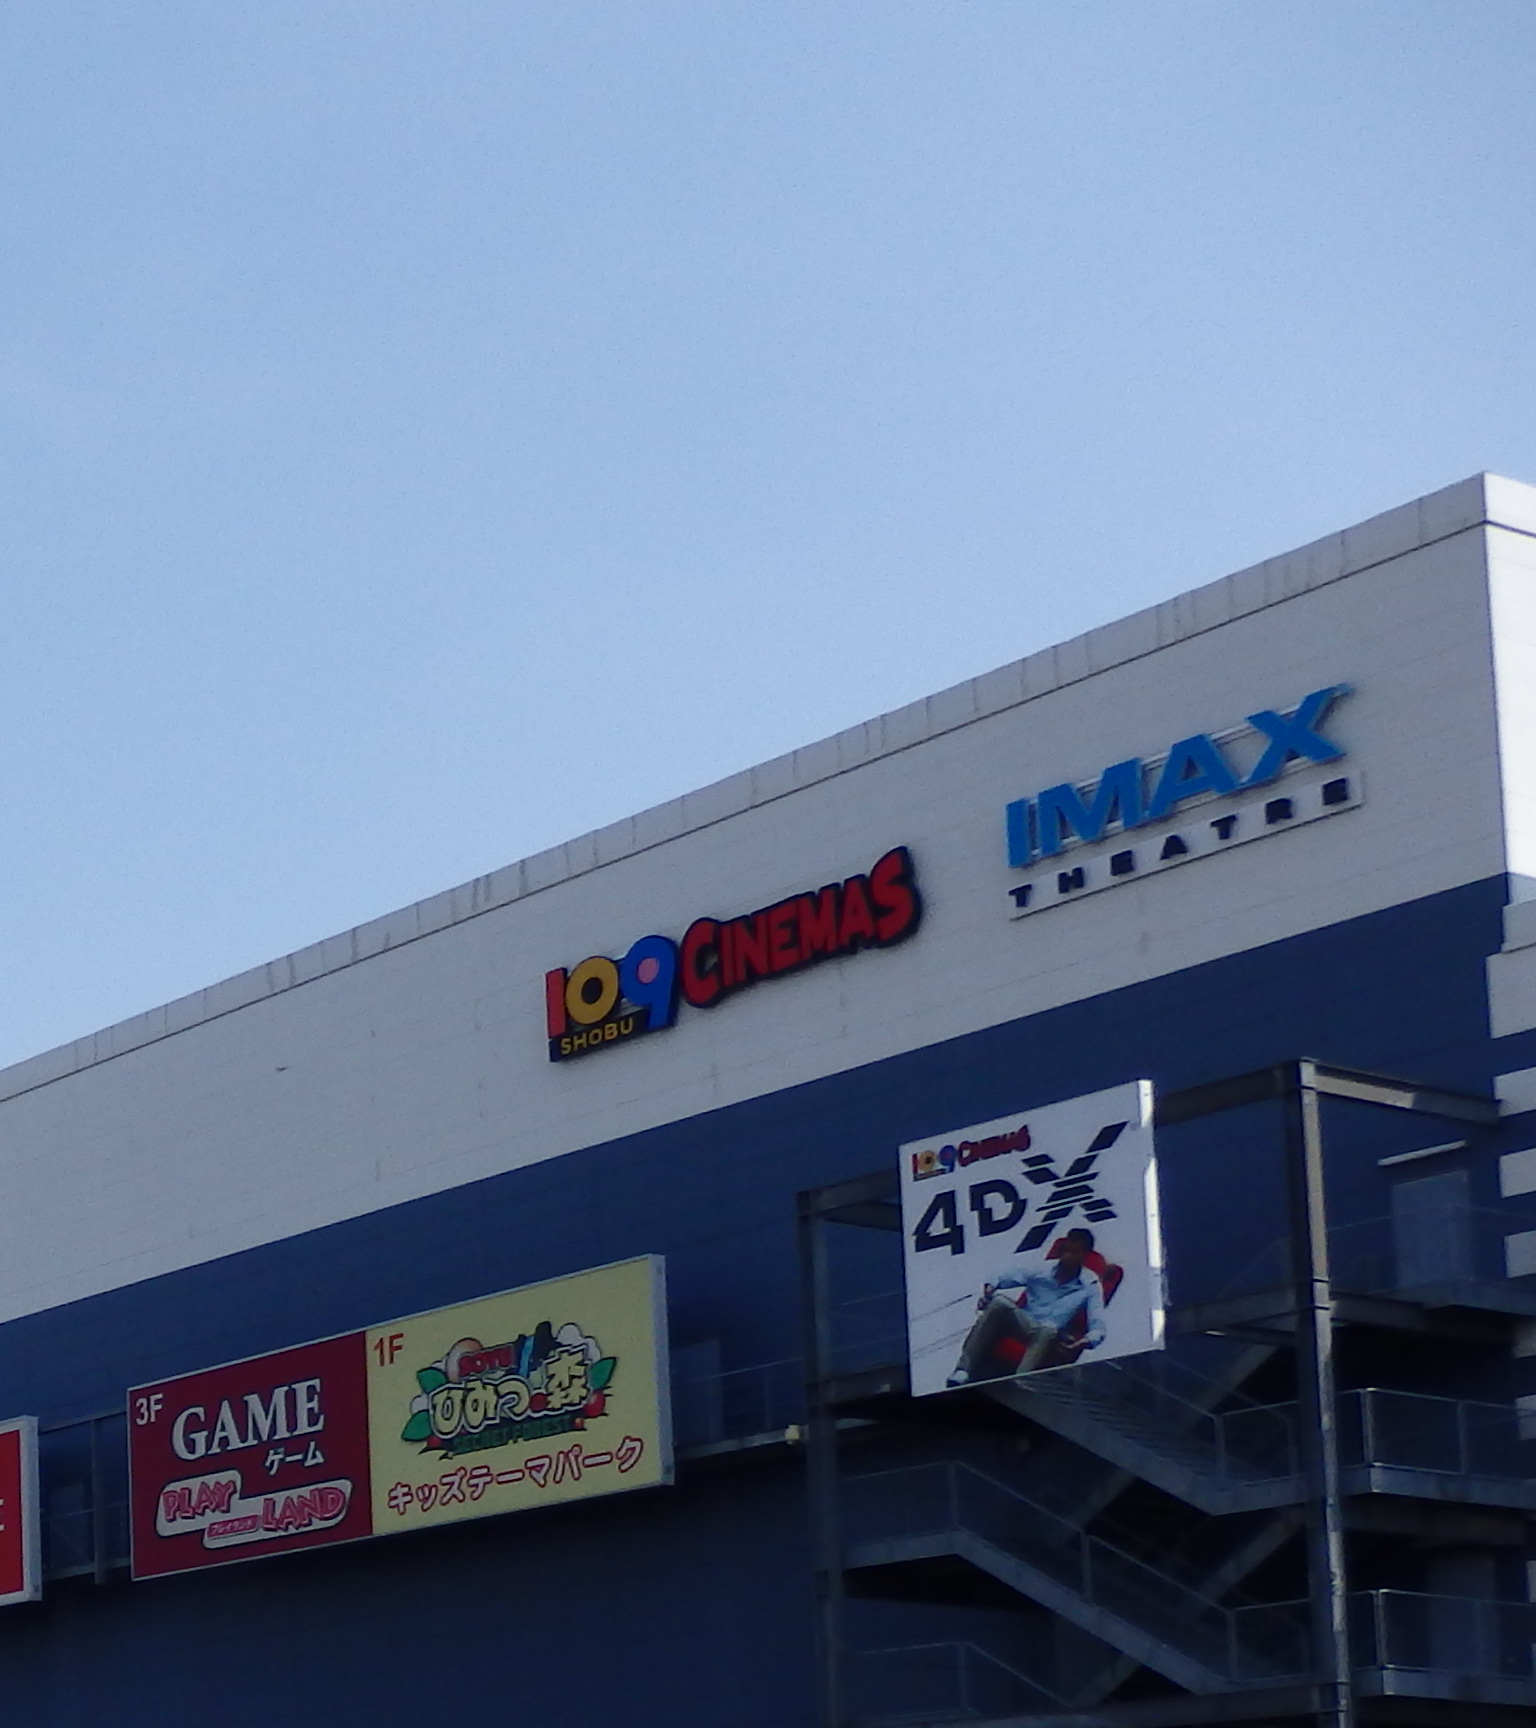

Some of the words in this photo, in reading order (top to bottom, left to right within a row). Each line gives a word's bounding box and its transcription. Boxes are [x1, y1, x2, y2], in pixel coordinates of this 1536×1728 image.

[1006, 682, 1356, 868] IMAX
[1008, 777, 1349, 908] THEATRE
[545, 934, 680, 1038] 109
[679, 846, 921, 1008] CINEMAS
[561, 1017, 634, 1055] SHOBU
[912, 1144, 958, 1181] 109
[913, 1120, 1130, 1256] 4DX
[373, 1332, 405, 1367] 1F
[135, 1393, 164, 1426] 3F
[171, 1378, 326, 1461] GAME
[264, 1441, 325, 1476] ゲーム
[387, 1436, 644, 1515] キッズテーマパーク
[162, 1479, 237, 1523] PLAY
[262, 1486, 348, 1532] LAND
